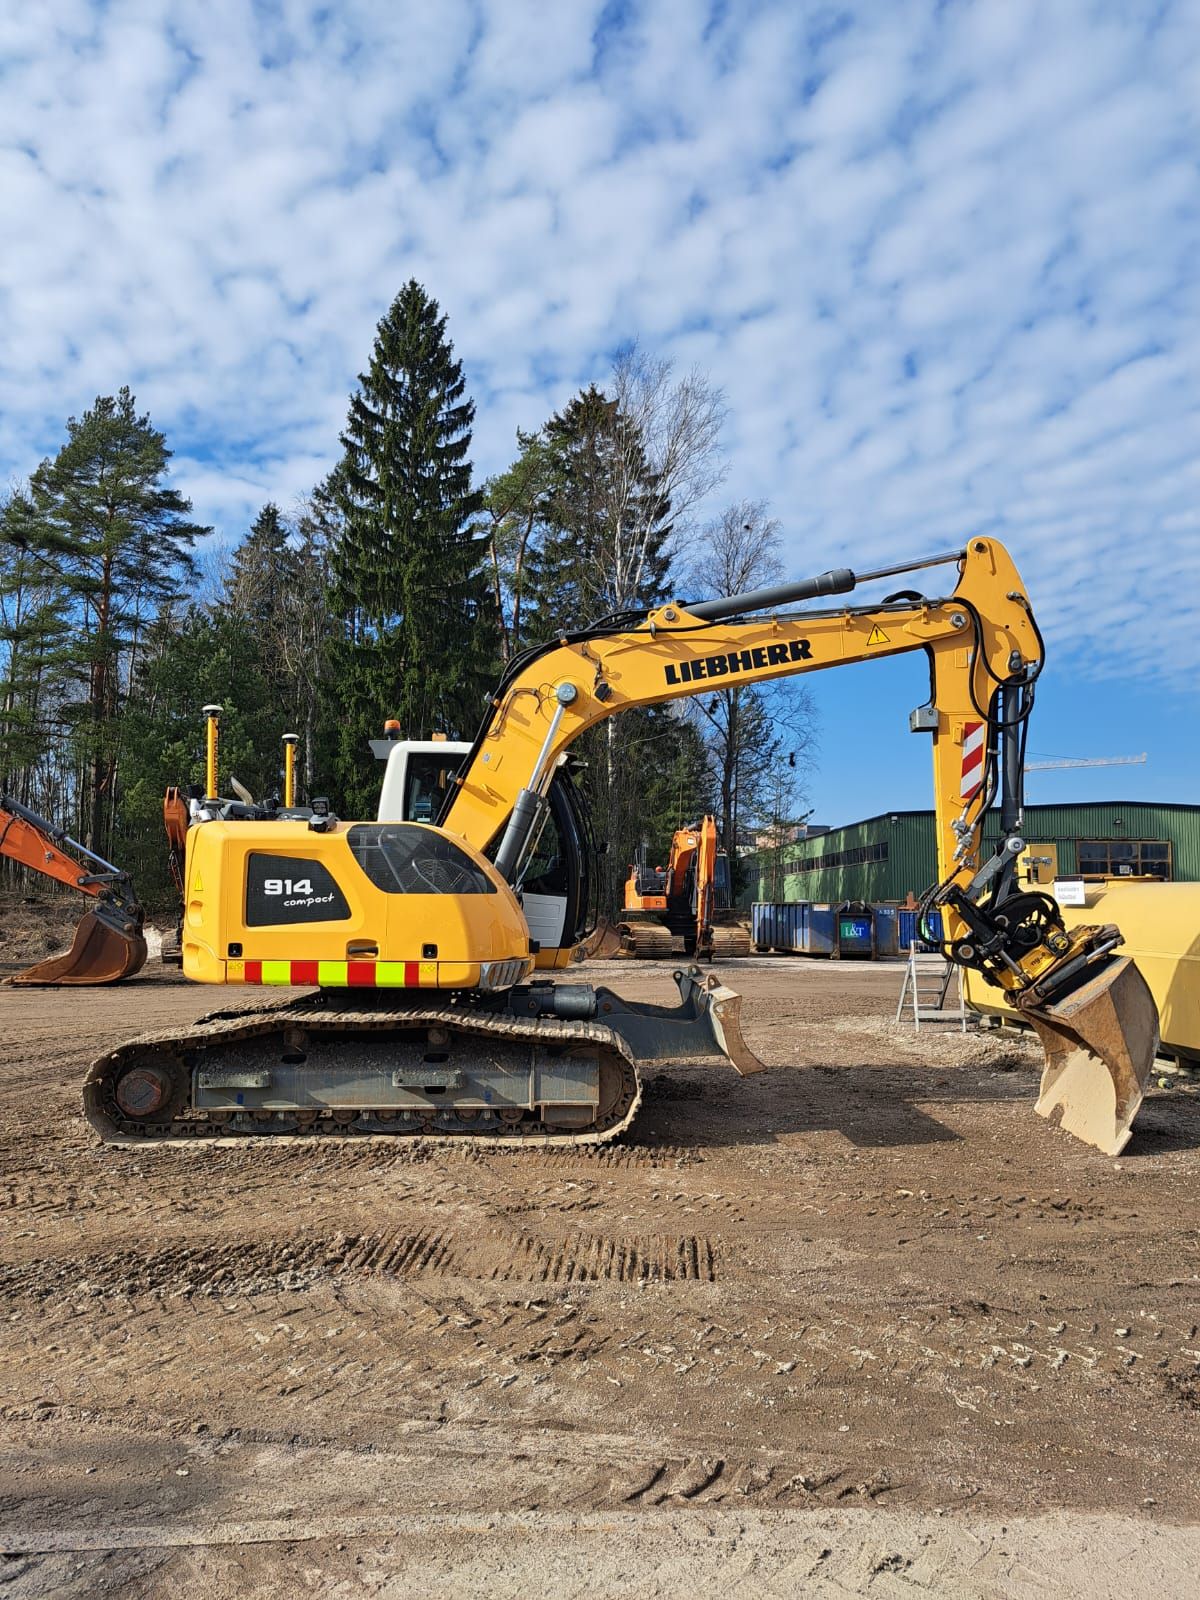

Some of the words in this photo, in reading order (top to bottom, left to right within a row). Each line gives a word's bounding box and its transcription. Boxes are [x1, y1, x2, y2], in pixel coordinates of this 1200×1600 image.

[664, 639, 813, 685] LIEBHERR
[264, 879, 313, 895] 914
[283, 892, 335, 907] compact
[845, 923, 865, 936] L&T
